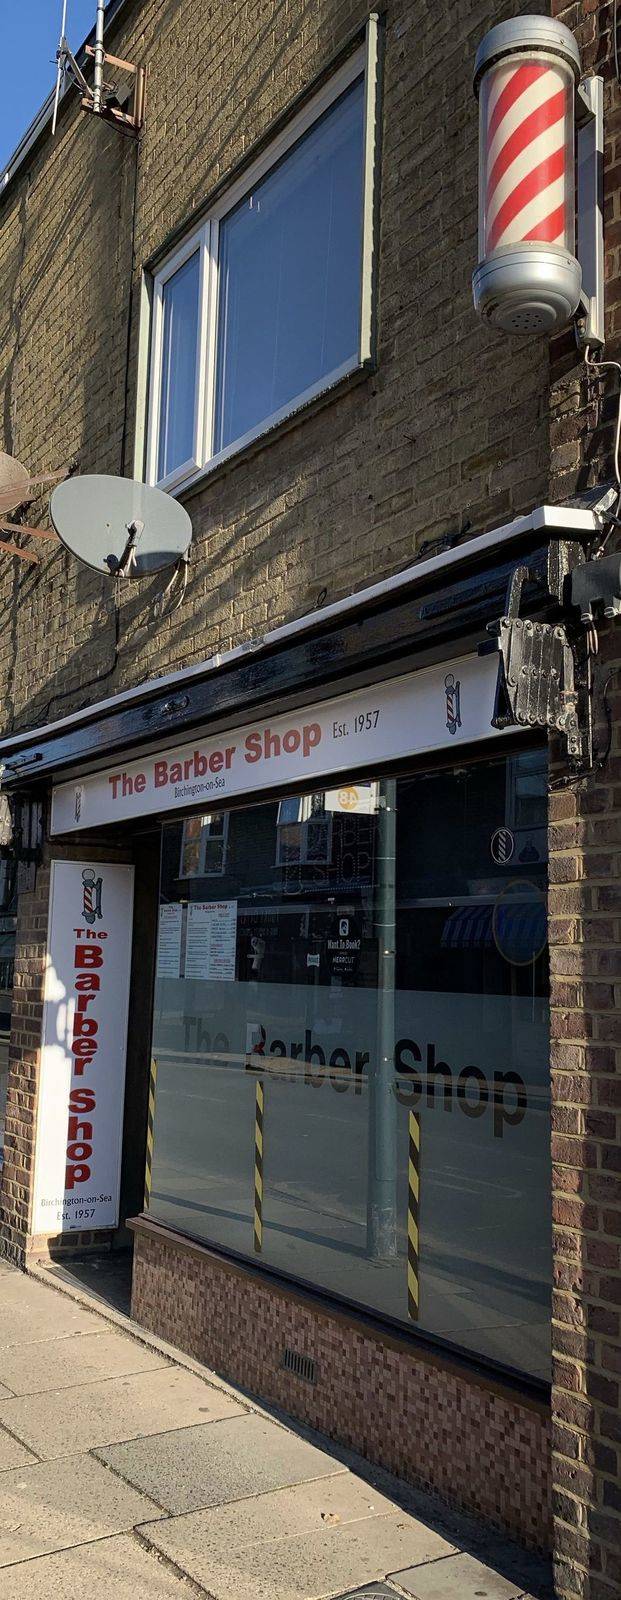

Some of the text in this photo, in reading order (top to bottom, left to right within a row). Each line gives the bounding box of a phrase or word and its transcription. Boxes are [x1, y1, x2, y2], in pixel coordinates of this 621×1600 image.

[332, 709, 381, 739] Est. 1957
[108, 722, 322, 800] The Barber Shop
[174, 776, 226, 799] Birchington-on-Sea
[73, 928, 109, 940] The
[71, 944, 104, 1076] Barber
[183, 1015, 528, 1138] The Barber Shop
[64, 1087, 97, 1190] Shop
[40, 1193, 112, 1207] Birchington-on-Sea
[57, 1208, 96, 1220] Est. 1957
